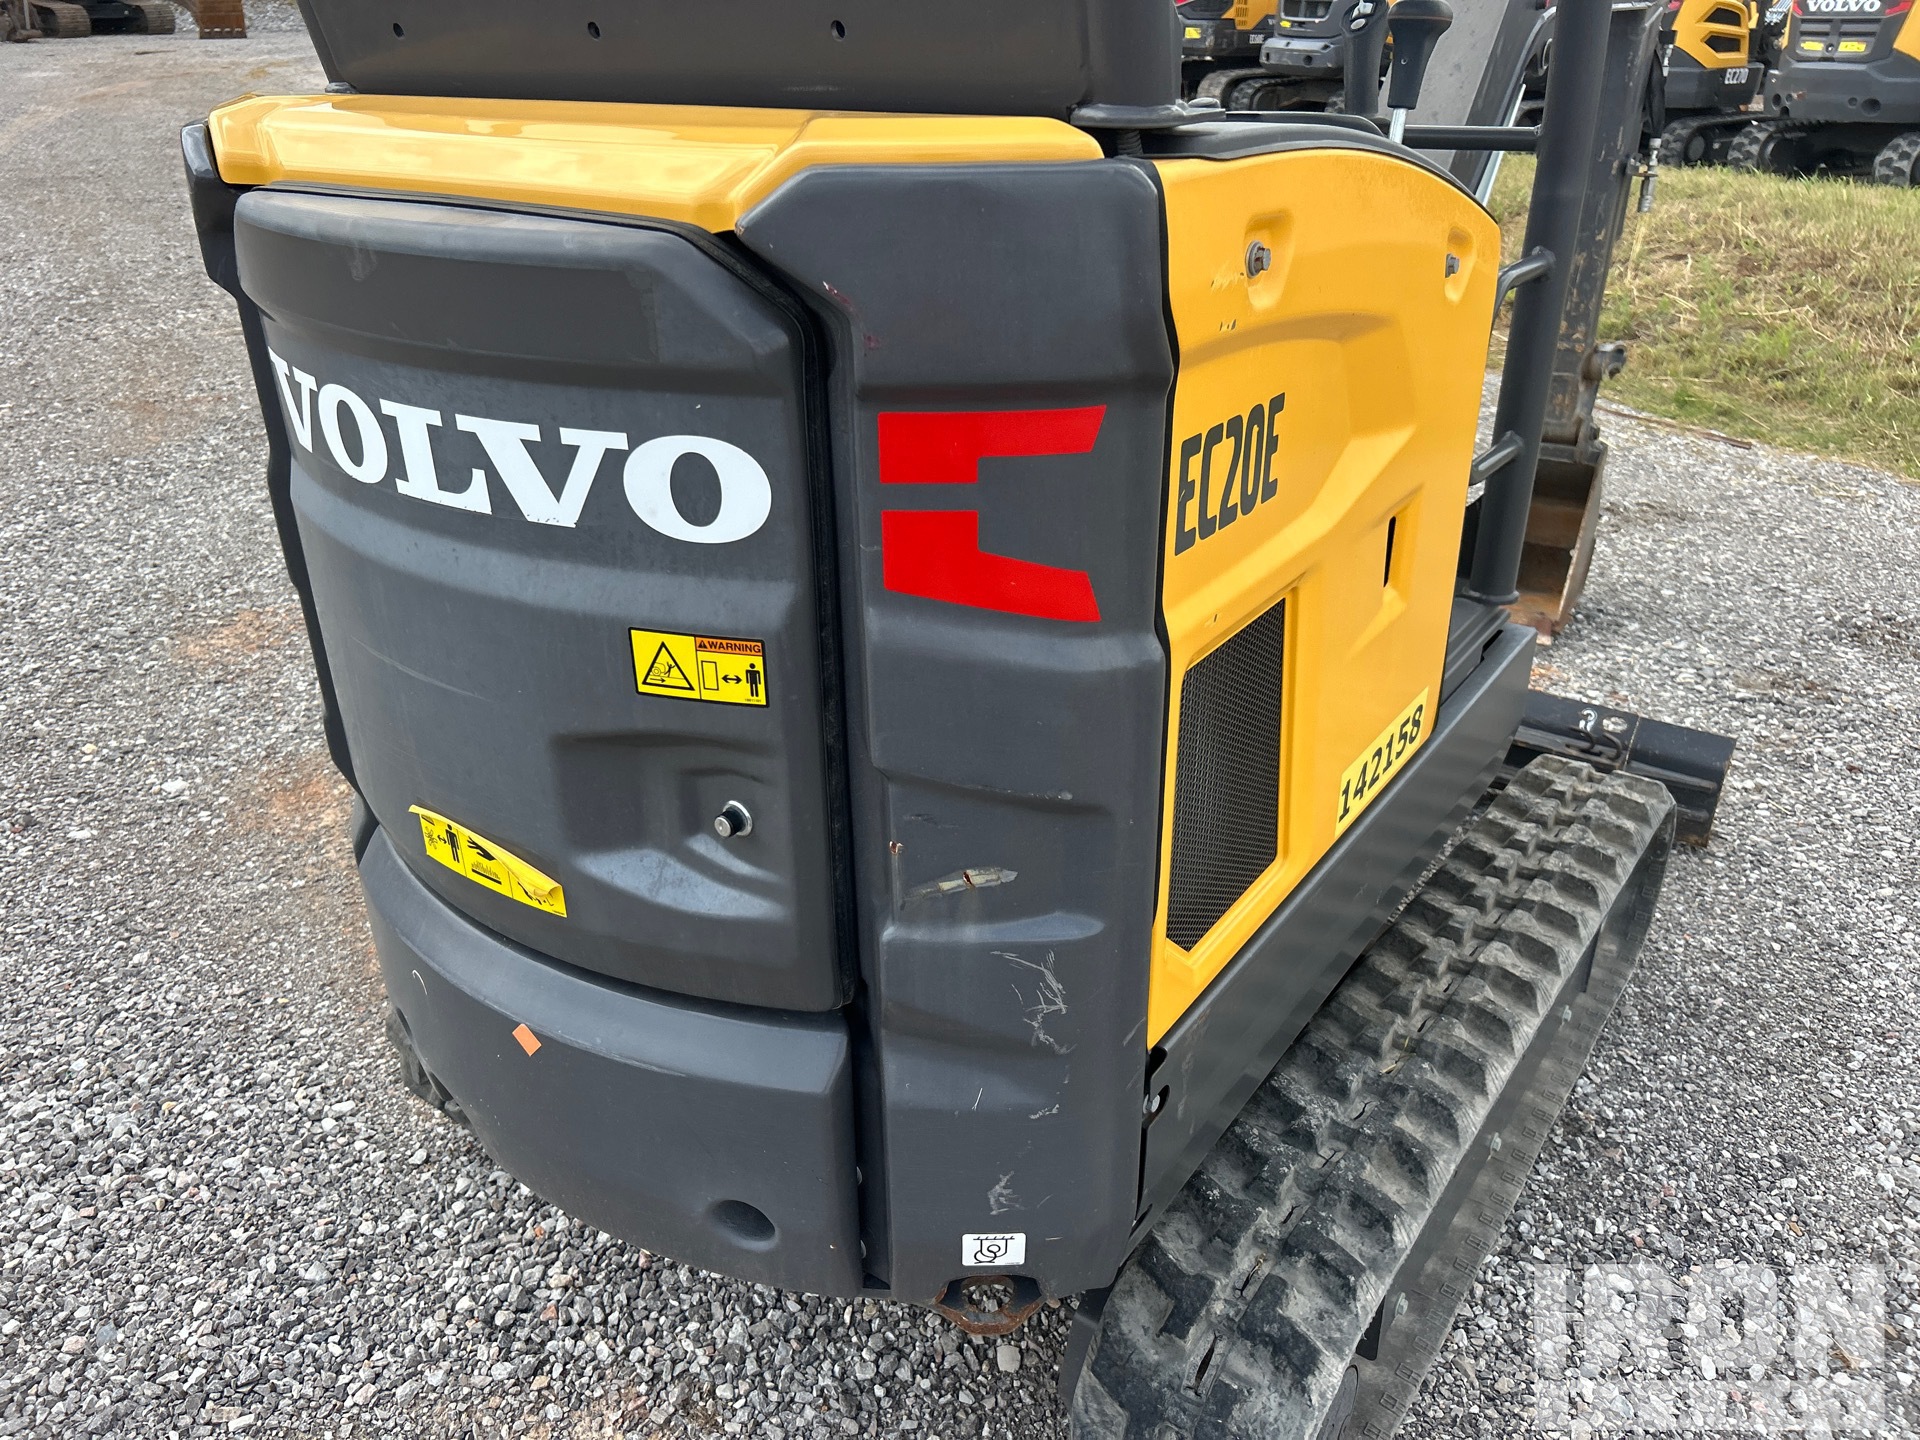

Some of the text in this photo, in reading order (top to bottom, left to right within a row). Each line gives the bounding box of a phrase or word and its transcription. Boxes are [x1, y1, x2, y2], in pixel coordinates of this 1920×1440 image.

[1806, 0, 1881, 12] VOLVO
[267, 346, 772, 544] VOLVO
[1174, 392, 1286, 557] EC20E
[707, 640, 762, 654] WARNING
[1338, 704, 1424, 824] 142158
